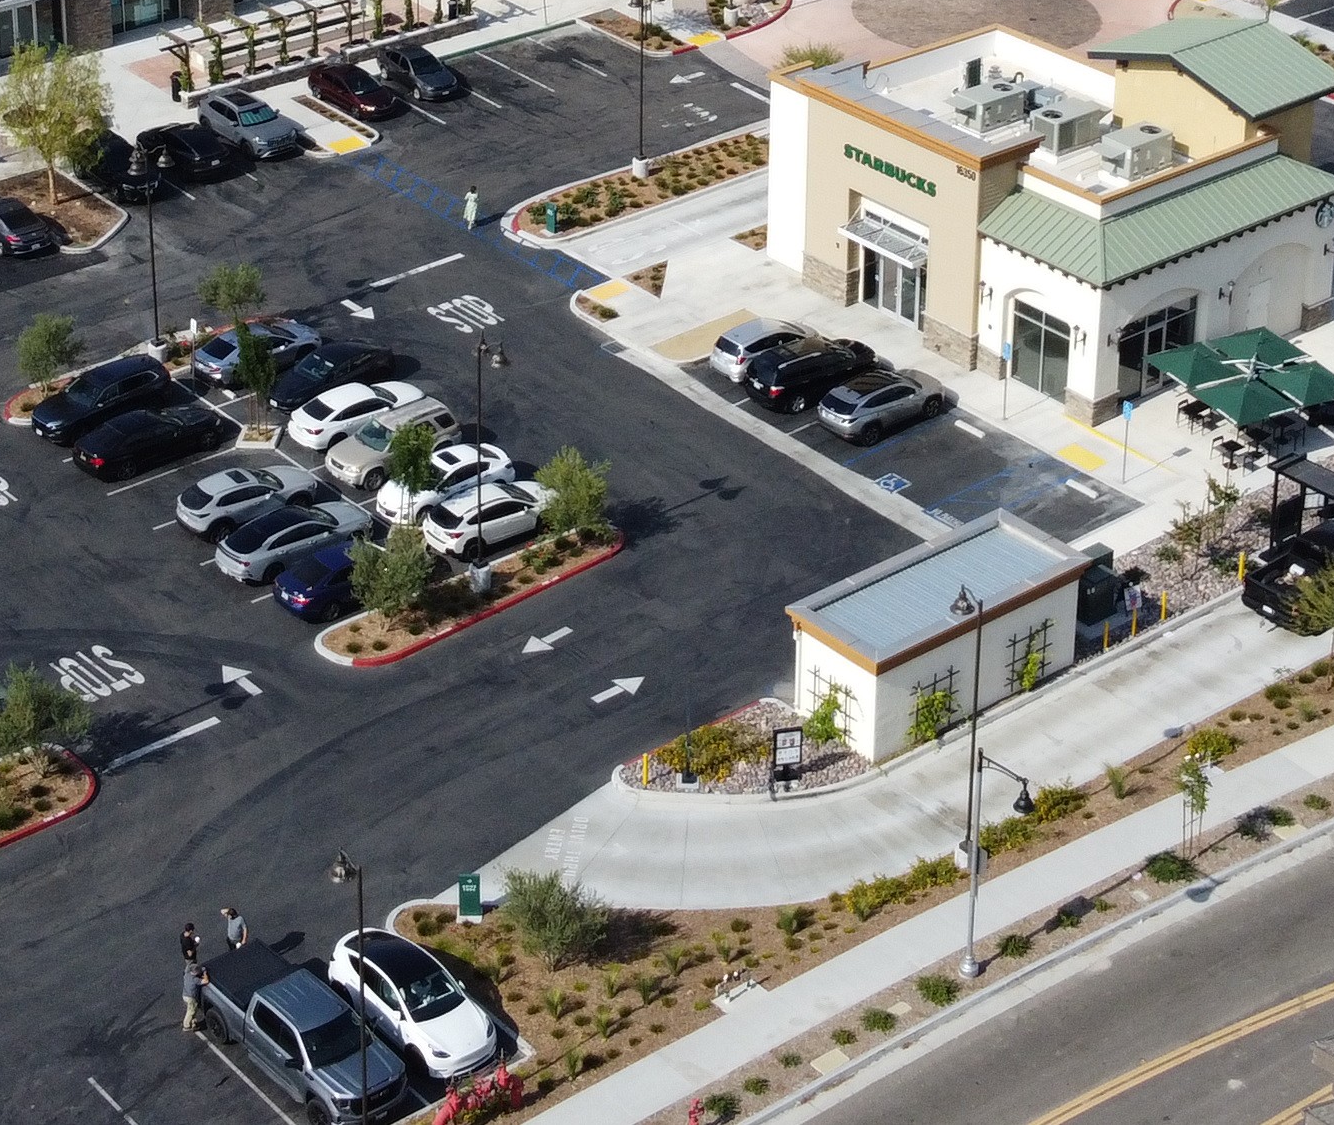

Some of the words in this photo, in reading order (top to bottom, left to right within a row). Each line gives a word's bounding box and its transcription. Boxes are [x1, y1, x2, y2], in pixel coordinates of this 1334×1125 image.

[844, 143, 937, 198] STARBUCKS
[956, 164, 976, 182] 16350
[427, 295, 505, 333] STOP
[49, 645, 146, 702] STOP
[544, 828, 566, 861] ENTRY
